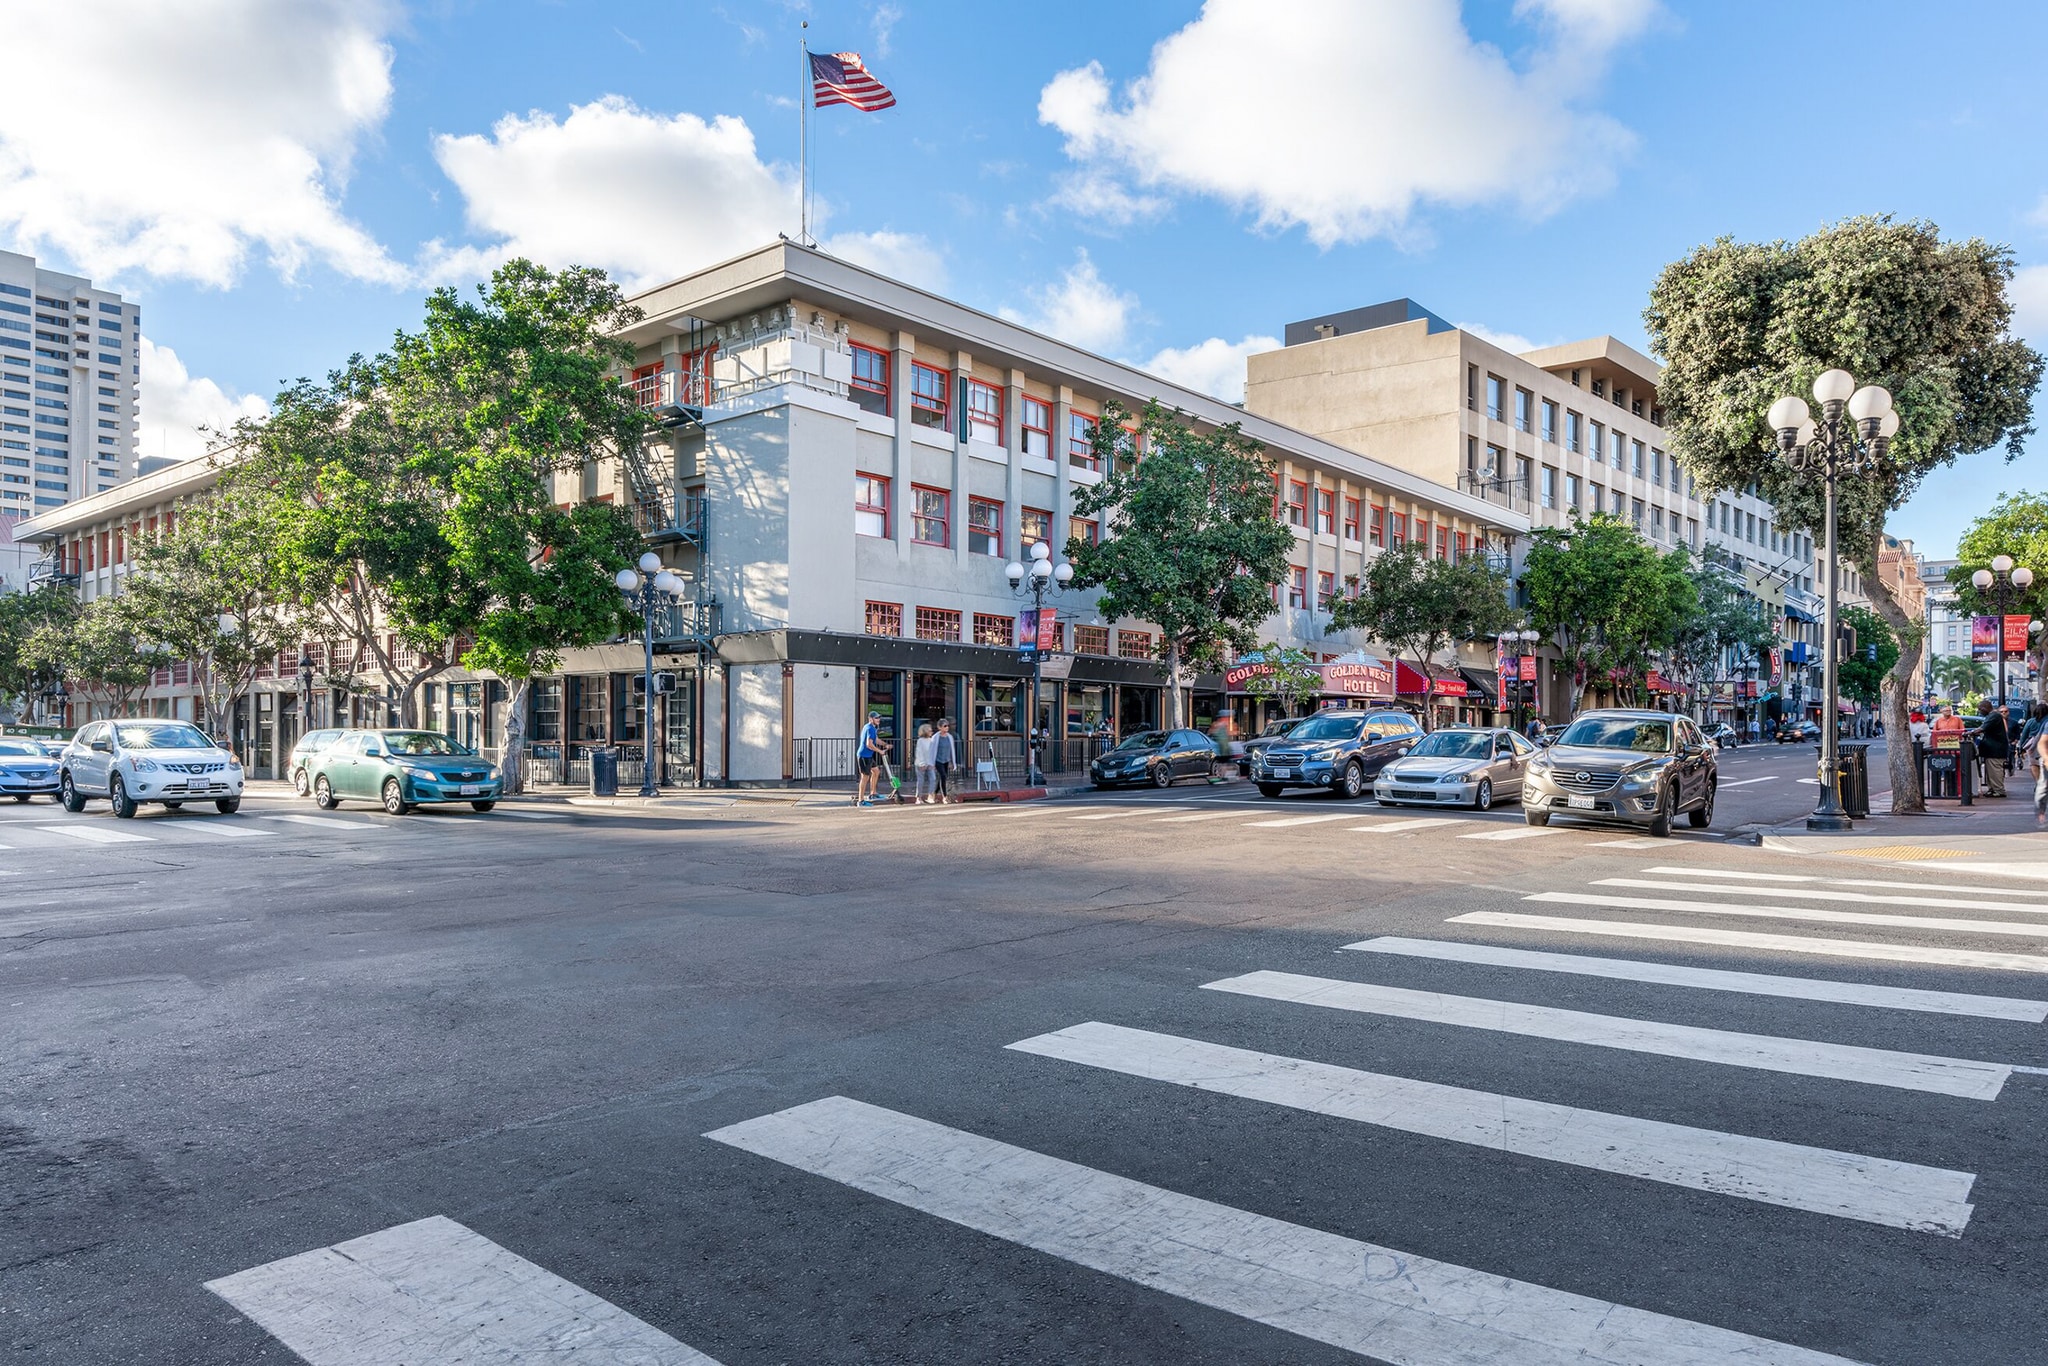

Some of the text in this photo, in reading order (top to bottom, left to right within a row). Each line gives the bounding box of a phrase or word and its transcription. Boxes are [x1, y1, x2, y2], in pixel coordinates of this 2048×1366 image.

[1330, 664, 1392, 684] GOLDEN WEST
[1343, 679, 1380, 693] HOTEL
